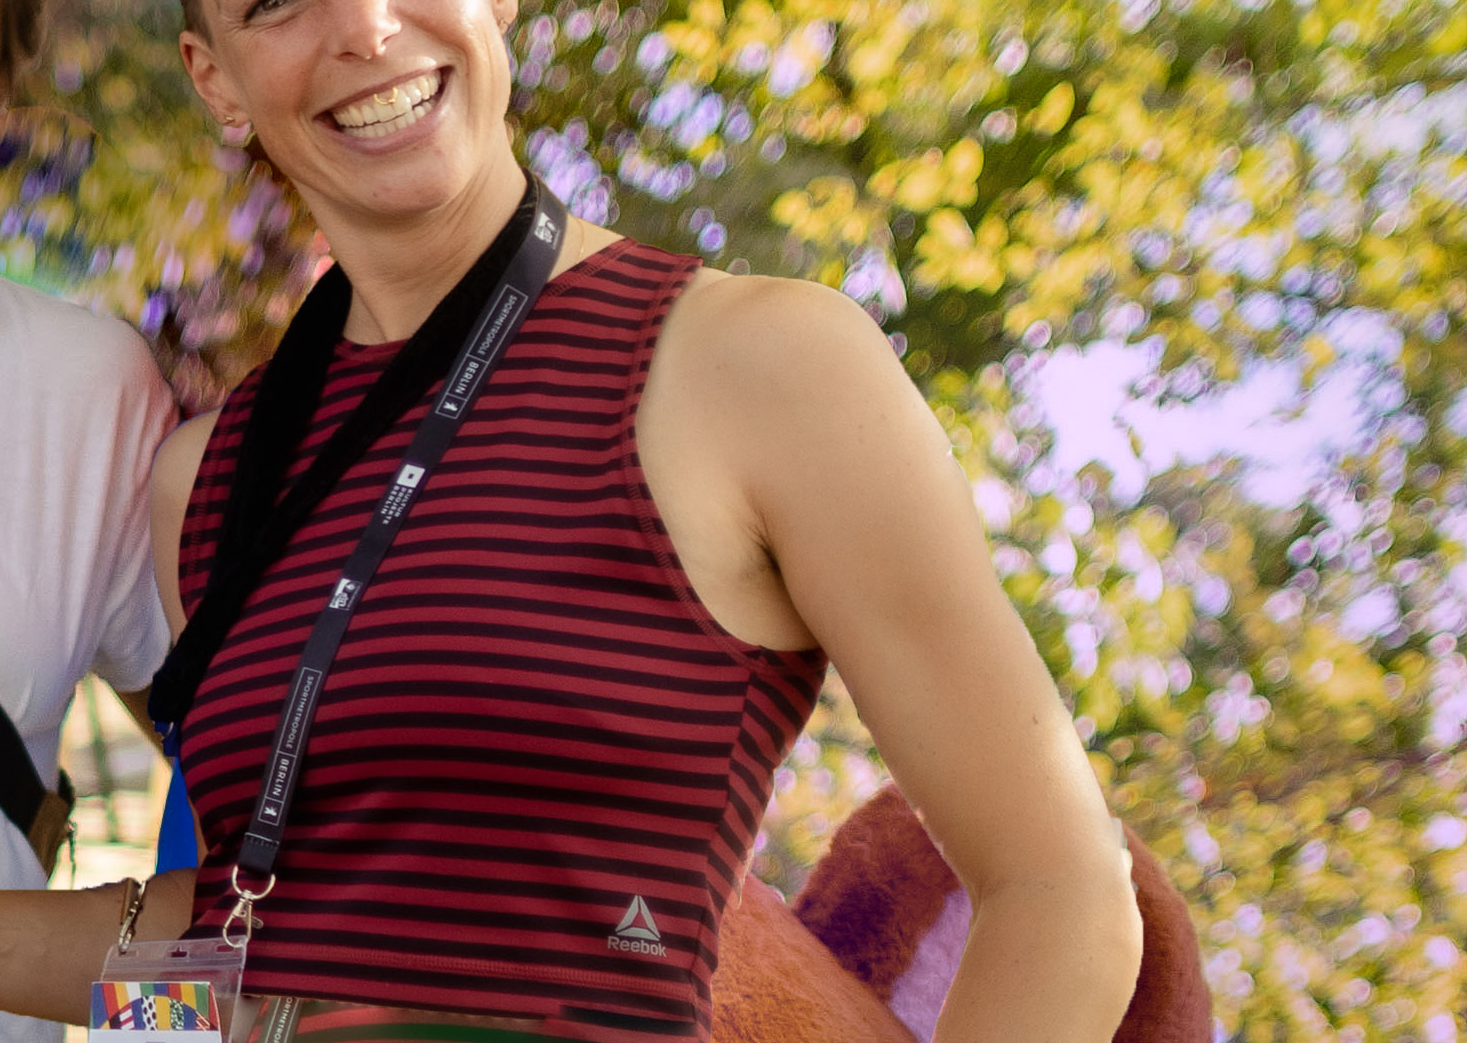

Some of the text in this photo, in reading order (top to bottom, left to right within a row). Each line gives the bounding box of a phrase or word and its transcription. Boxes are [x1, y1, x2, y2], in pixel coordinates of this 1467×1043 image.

[478, 294, 518, 356] SPORTMETROPOLE
[455, 360, 480, 395] BERLIN
[380, 484, 400, 515] BERLIN
[382, 487, 408, 525] PROJEKTE
[394, 488, 414, 518] KULTUR
[285, 675, 315, 750] SPORTMETROPOLE
[272, 758, 290, 797] BERLIN
[607, 935, 667, 957] Reebok
